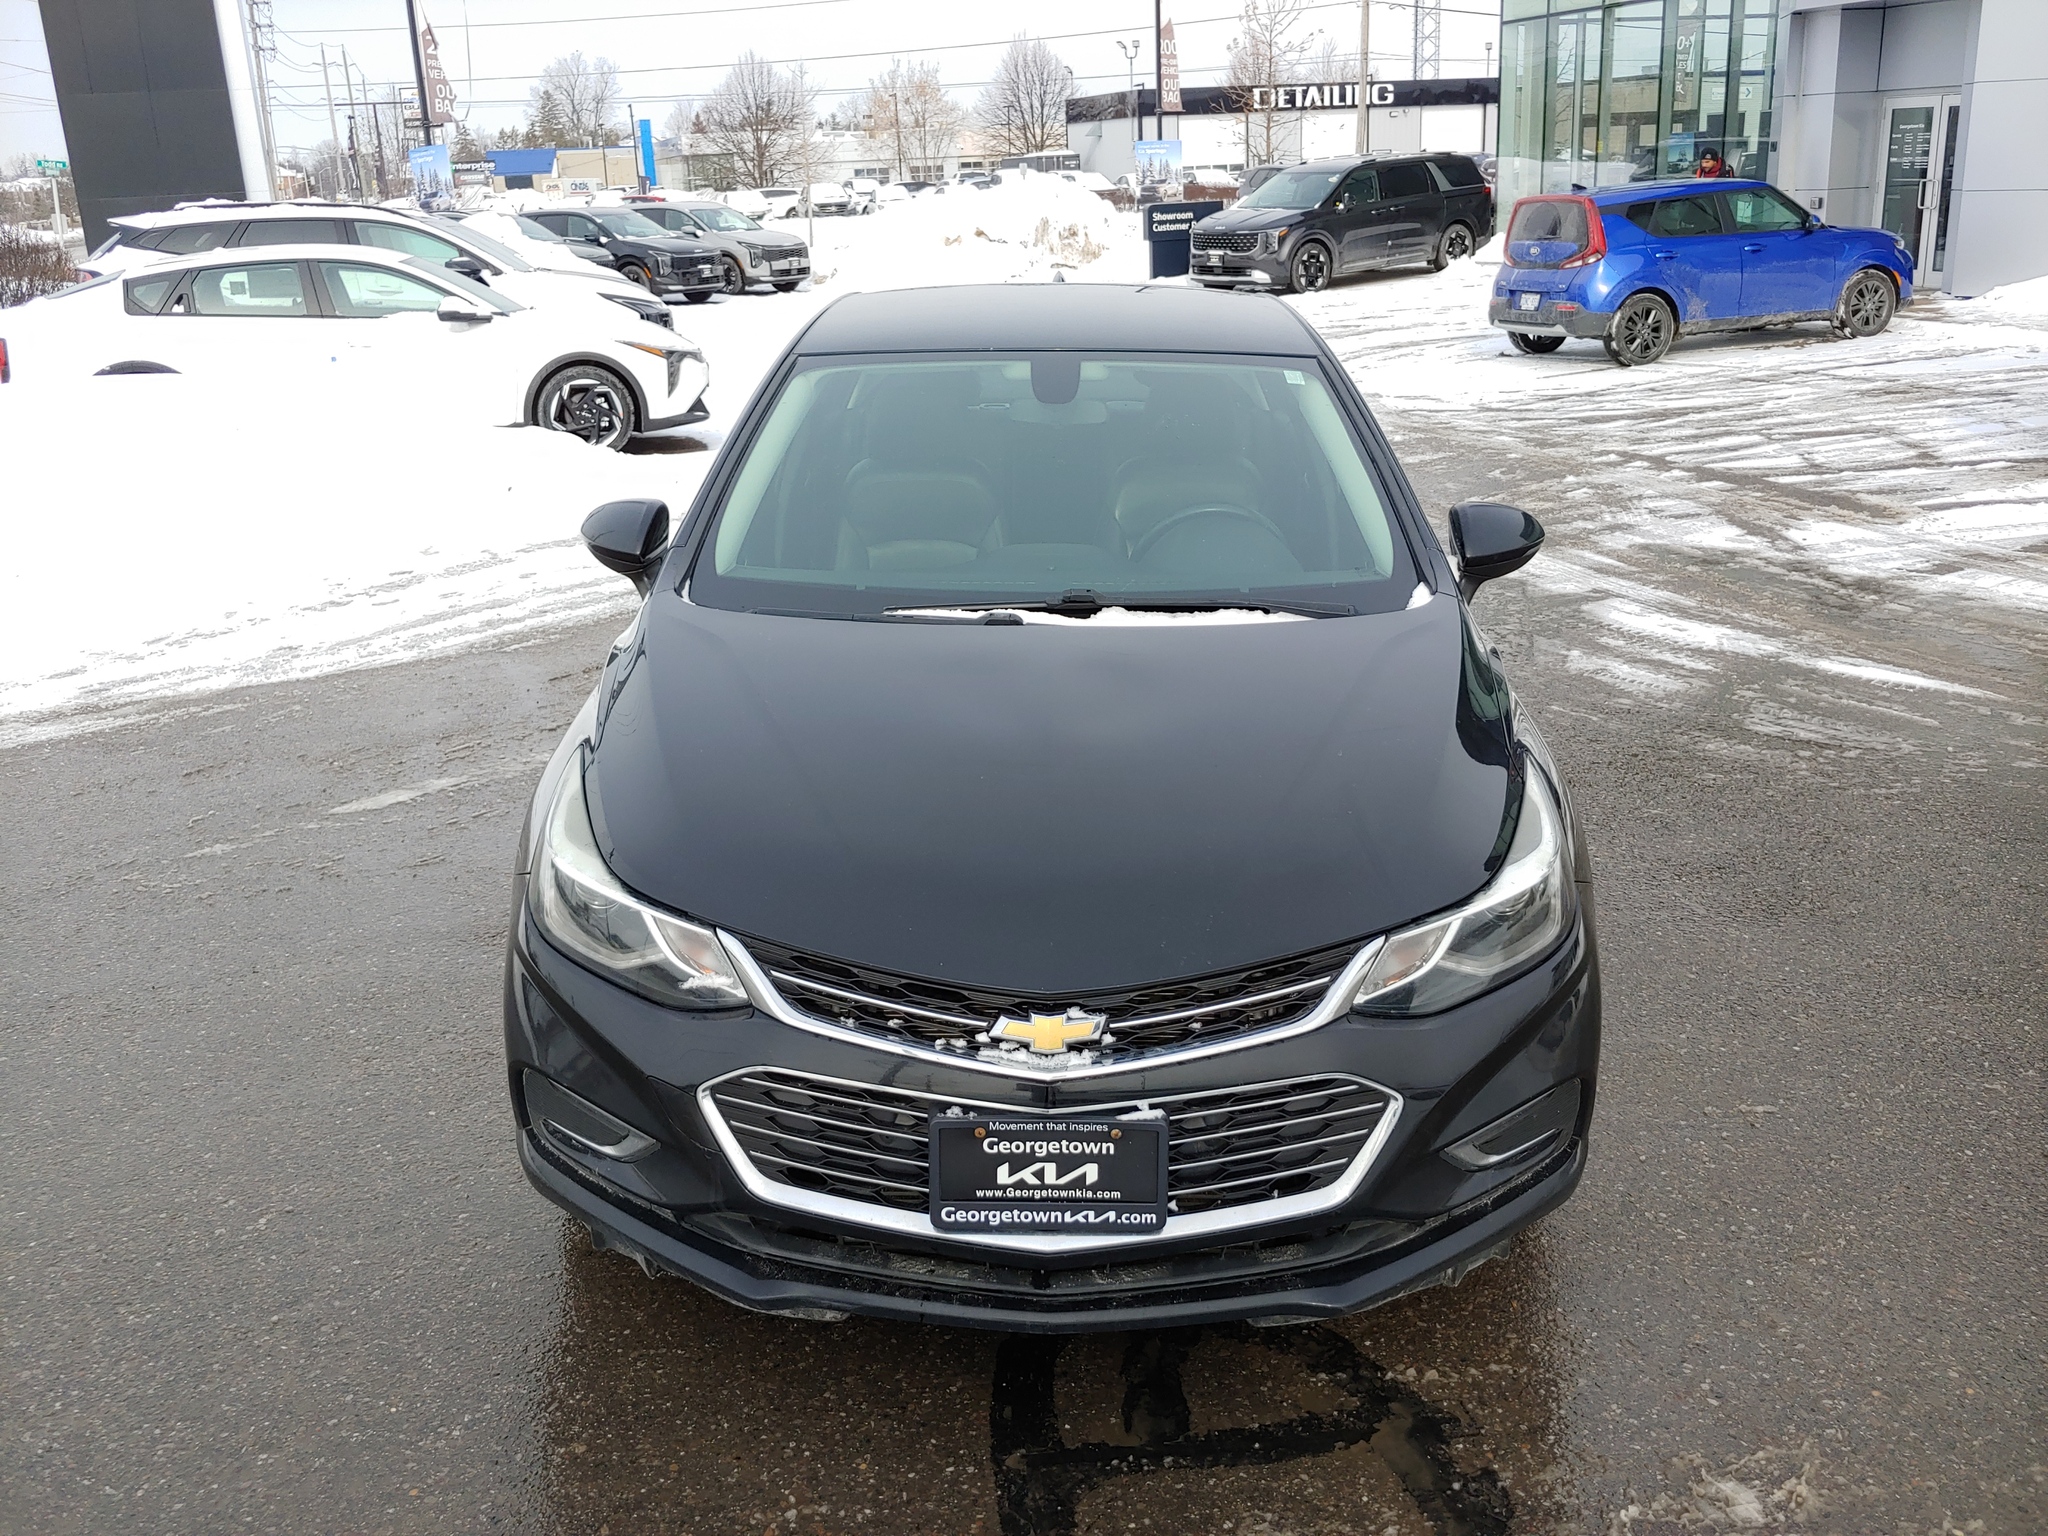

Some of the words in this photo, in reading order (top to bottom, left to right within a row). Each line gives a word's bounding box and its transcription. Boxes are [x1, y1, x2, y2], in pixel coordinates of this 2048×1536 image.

[1252, 83, 1395, 109] DETAILING
[1152, 212, 1194, 221] Showroom
[1152, 223, 1190, 232] Customer
[989, 1122, 1043, 1132] Movement
[1046, 1122, 1066, 1132] that
[1069, 1122, 1109, 1133] inspires
[983, 1137, 1115, 1157] Georgetown
[997, 1162, 1099, 1185] KIA
[975, 1187, 1122, 1200] www.Georgetownkia.com
